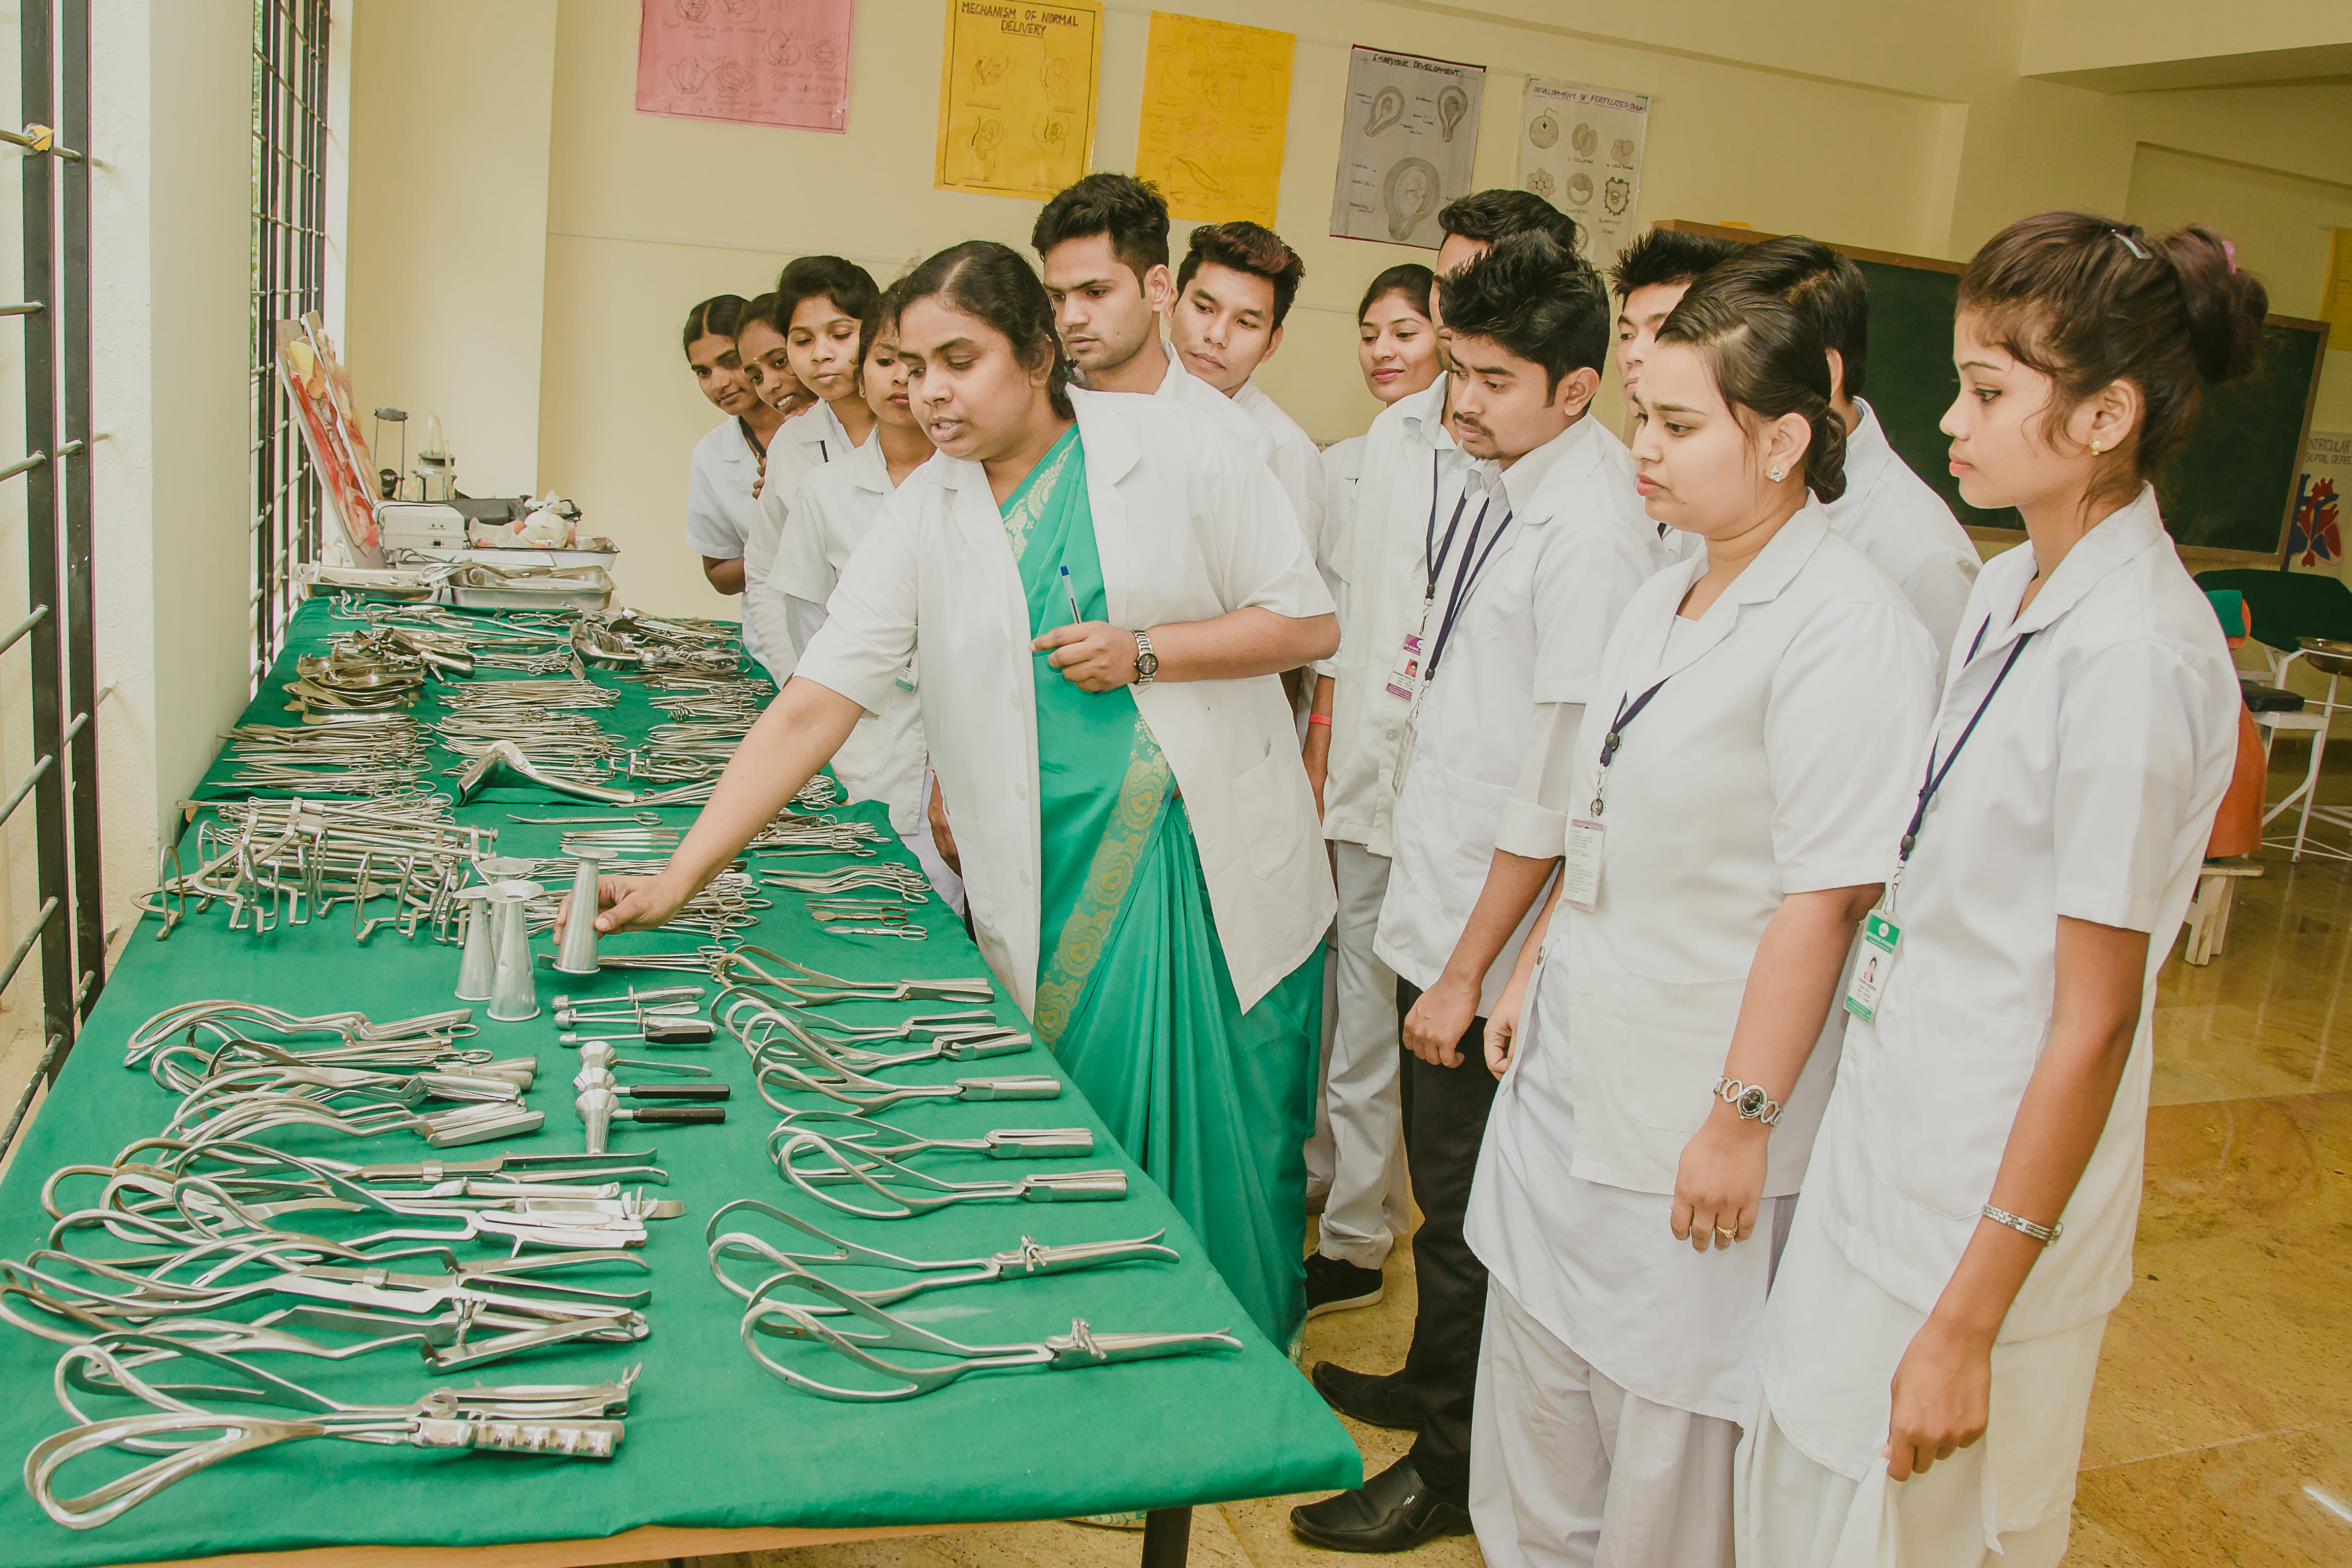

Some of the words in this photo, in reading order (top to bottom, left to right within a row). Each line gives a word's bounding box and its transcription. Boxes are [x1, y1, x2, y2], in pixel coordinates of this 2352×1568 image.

[962, 3, 1016, 19] MECHANISM
[1025, 10, 1037, 21] OF
[1041, 12, 1079, 26] NORMAL
[1001, 19, 1047, 36] DELIVERY
[1372, 54, 1409, 67] EMBRYONIC
[1413, 60, 1460, 76] DEVELOPMENT
[1533, 86, 1577, 100] DEVELOPMENT
[1590, 95, 1629, 108] FERTILIZED
[1629, 103, 1645, 112] OVUM
[2304, 451, 2328, 464] SEPTAL
